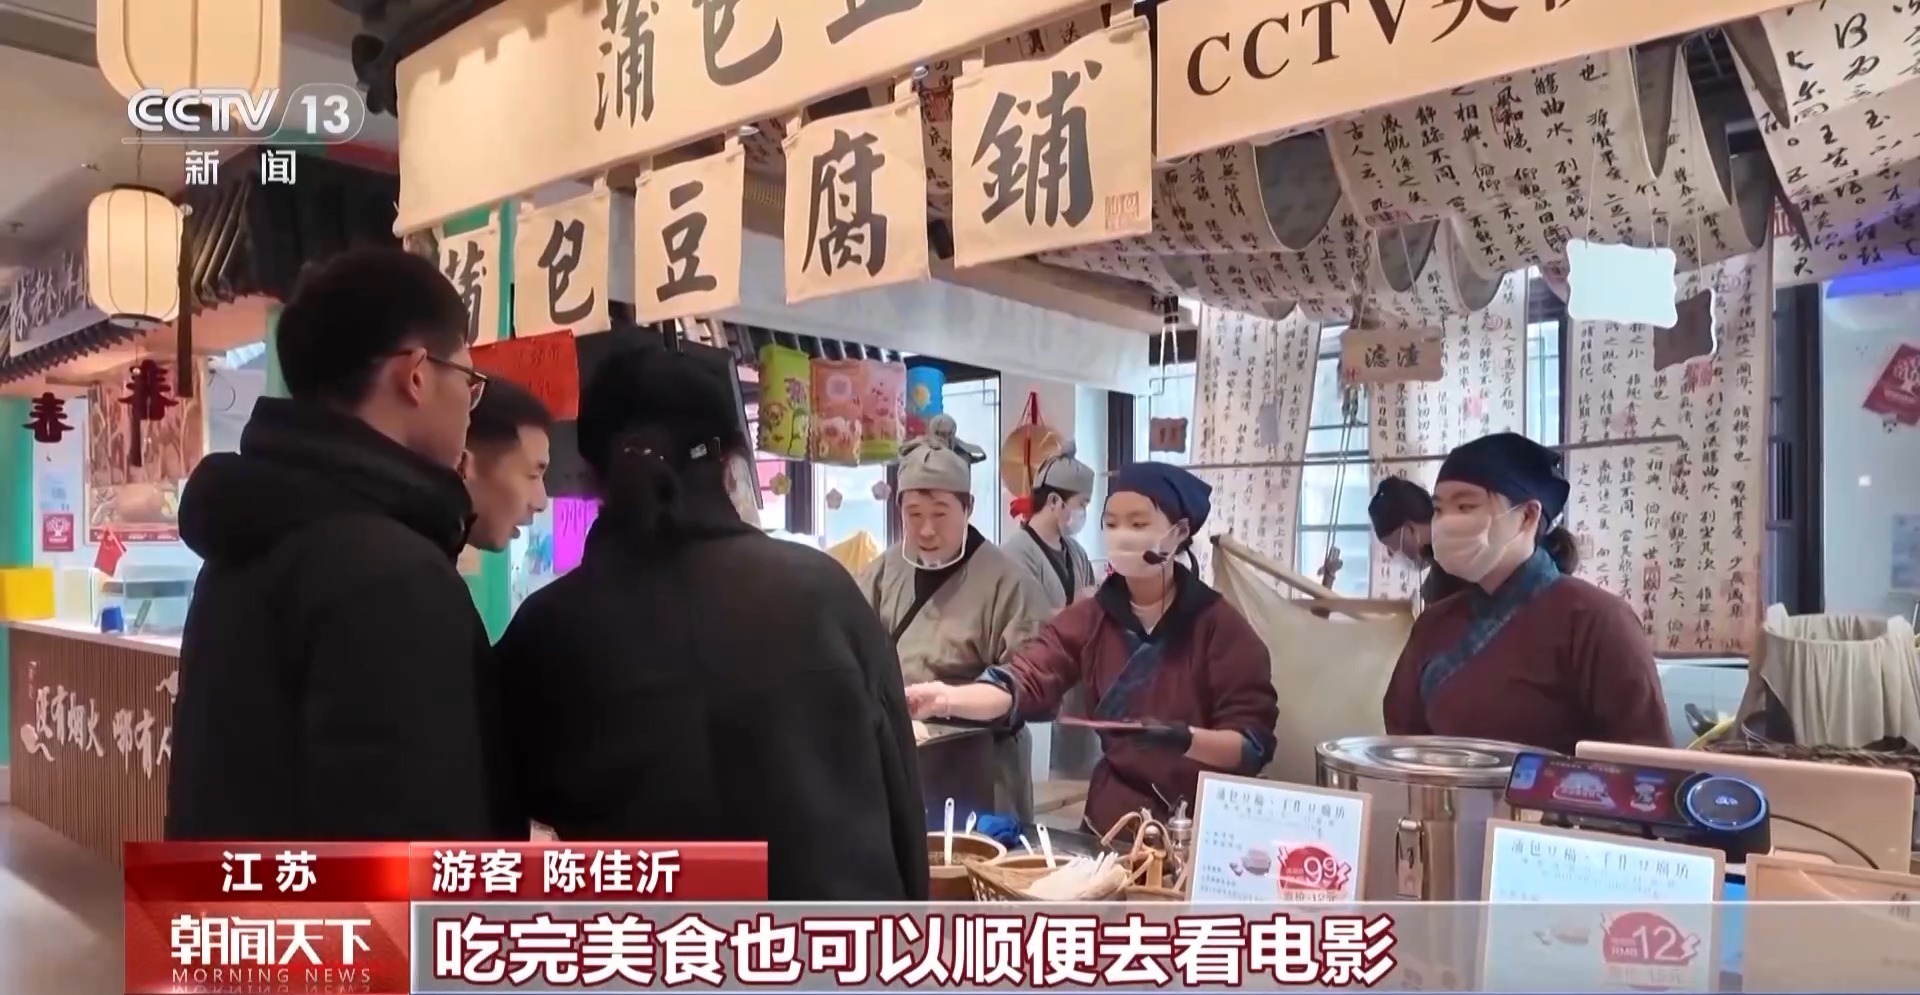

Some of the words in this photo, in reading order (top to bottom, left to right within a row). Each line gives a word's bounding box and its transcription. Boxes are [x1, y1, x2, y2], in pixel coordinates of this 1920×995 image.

[1365, 342, 1419, 369] 滤渣
[22, 391, 75, 443] 春
[1632, 925, 1682, 961] 12
